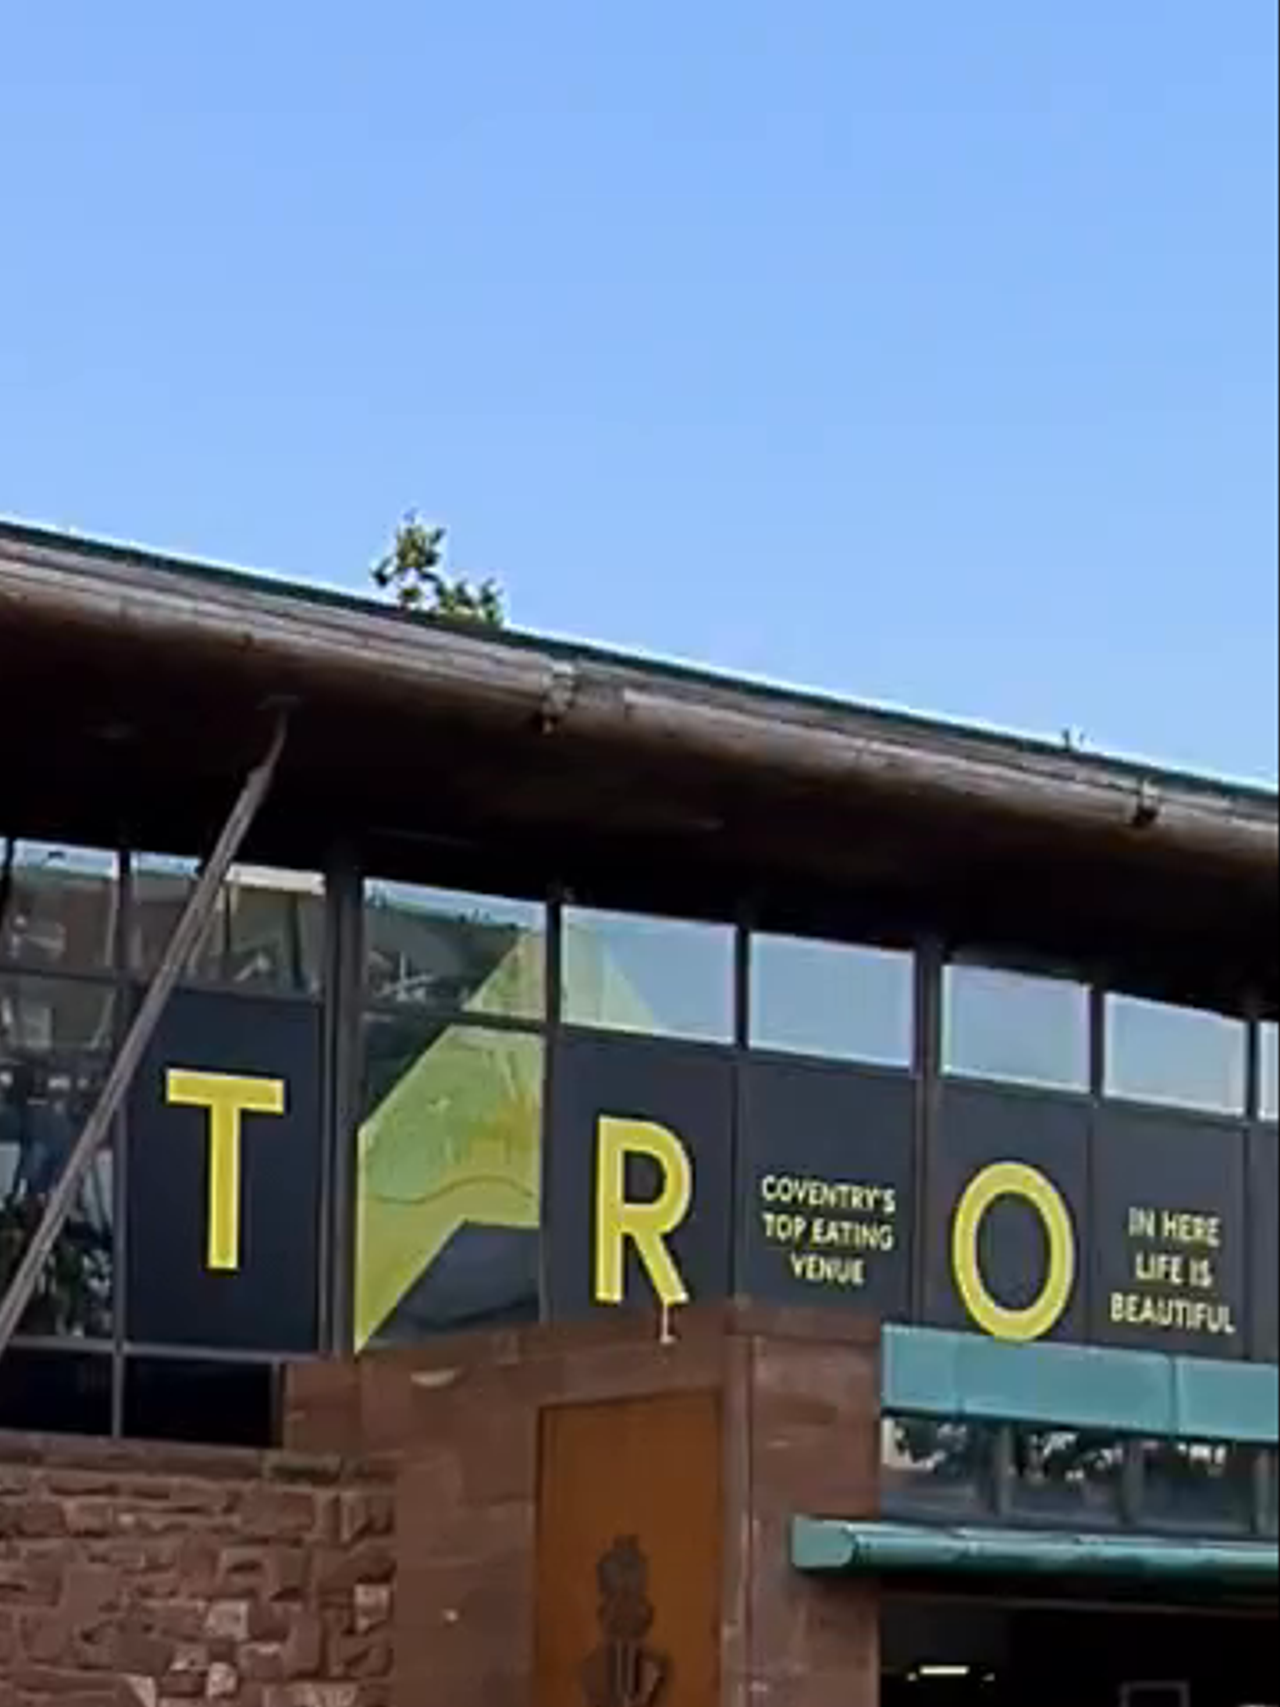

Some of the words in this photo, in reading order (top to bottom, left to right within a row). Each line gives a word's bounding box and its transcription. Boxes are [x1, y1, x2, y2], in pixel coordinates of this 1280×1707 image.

[762, 1174, 896, 1214] COVENTRY'S
[762, 1211, 807, 1241] TOP
[812, 1218, 894, 1252] EATING
[1127, 1205, 1156, 1238] IN
[1161, 1210, 1220, 1248] HERE
[790, 1252, 864, 1286] VENUE
[1135, 1253, 1183, 1285] LIFE
[1190, 1258, 1214, 1288] IS
[1110, 1292, 1237, 1334] BEAUTIFUL
